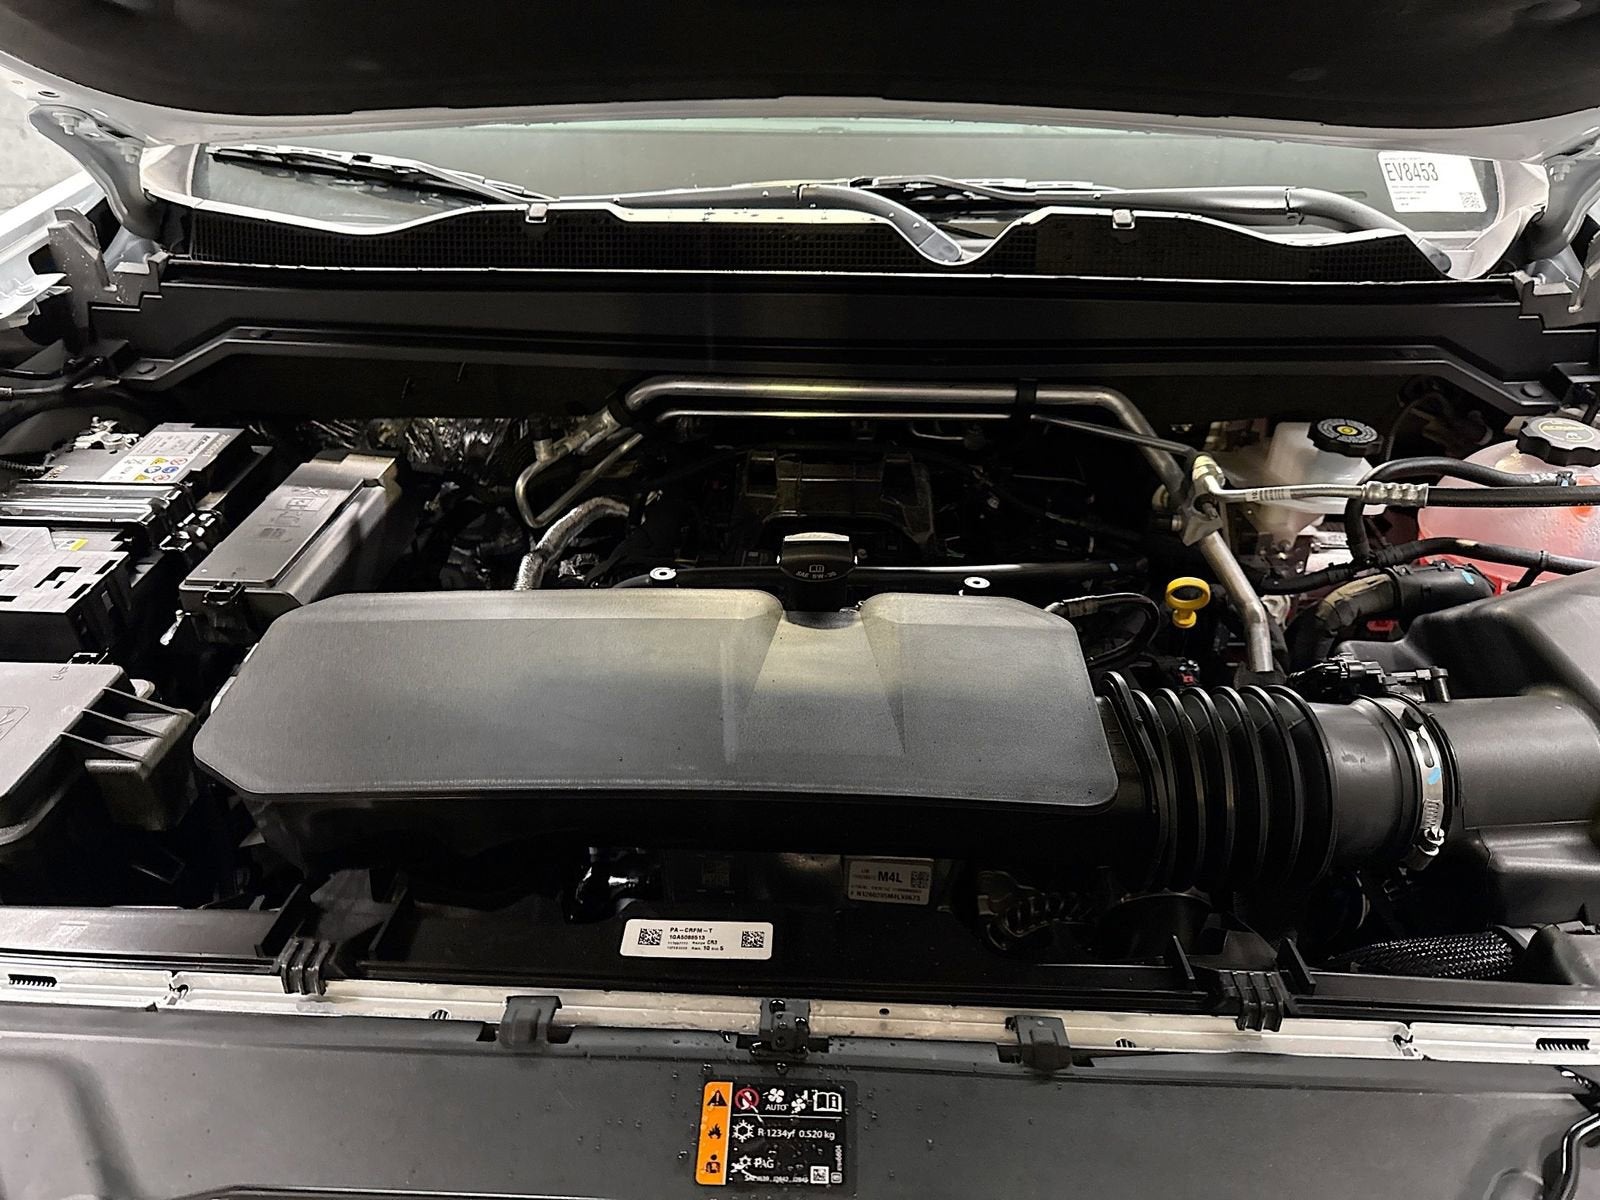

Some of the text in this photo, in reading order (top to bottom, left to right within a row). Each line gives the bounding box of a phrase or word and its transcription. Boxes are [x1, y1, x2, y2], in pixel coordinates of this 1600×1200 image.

[1384, 162, 1439, 181] EV8453
[878, 871, 903, 883] M4L
[765, 1103, 787, 1111] AUTO
[798, 1130, 823, 1139] 0.520
[824, 1130, 836, 1141] kg
[753, 1157, 775, 1169] PAG
